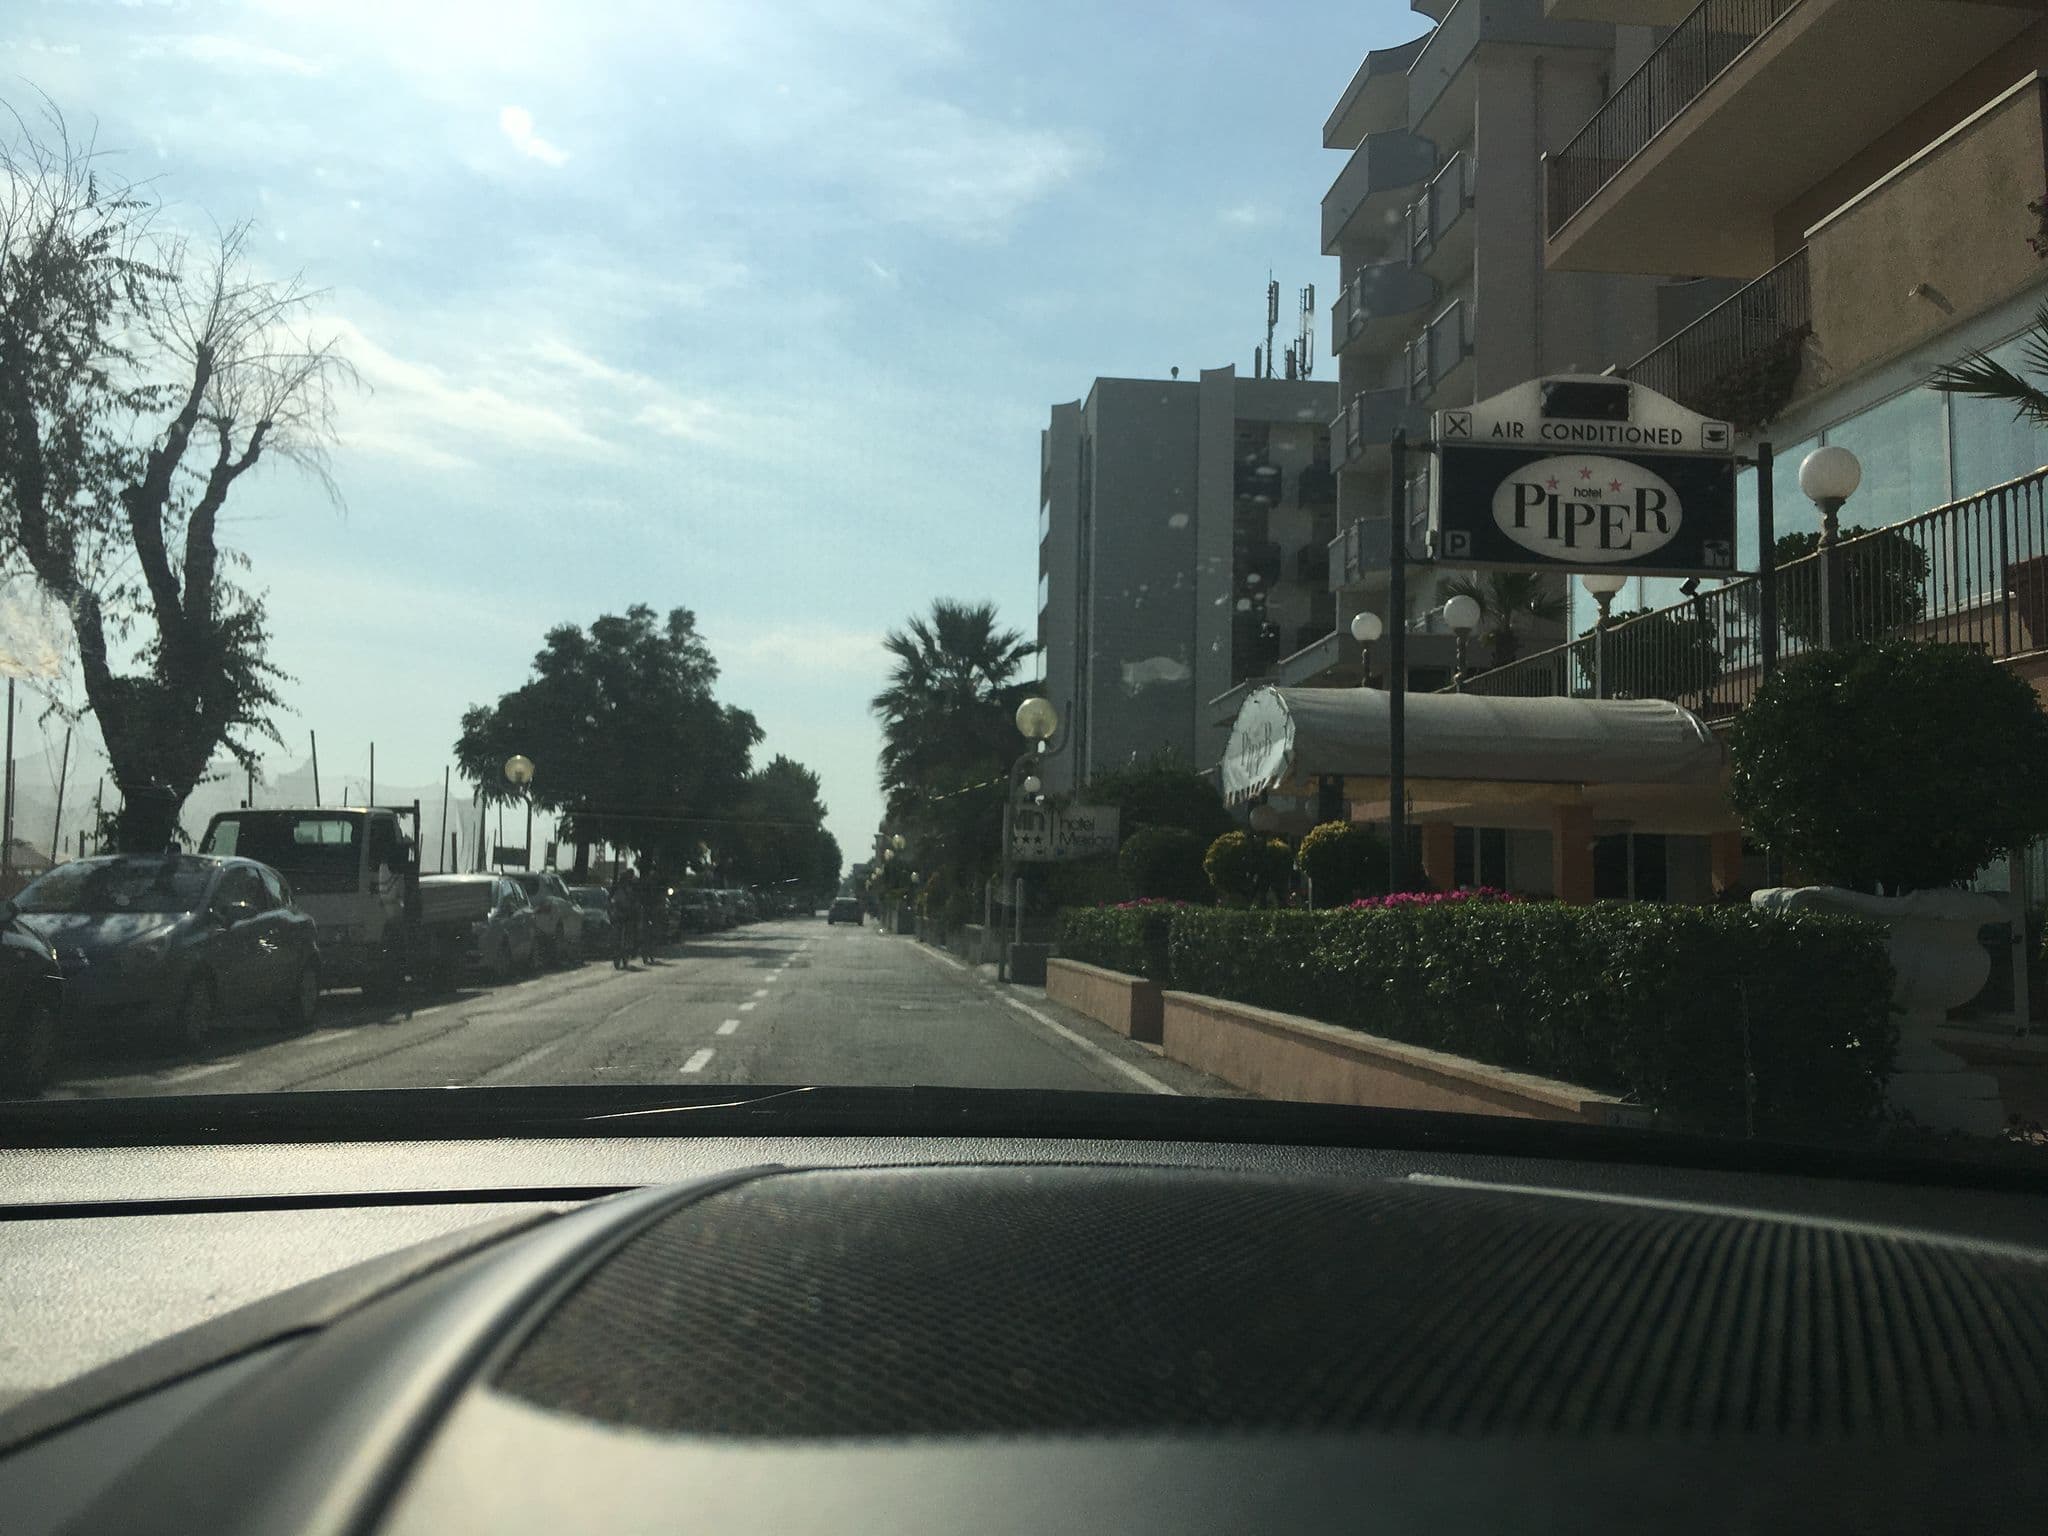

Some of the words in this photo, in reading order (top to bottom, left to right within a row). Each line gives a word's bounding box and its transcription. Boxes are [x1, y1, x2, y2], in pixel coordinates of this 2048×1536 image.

[1491, 421, 1525, 439] AIR
[1540, 422, 1684, 446] CONDITIONED
[1573, 485, 1602, 499] hotel
[1511, 482, 1672, 551] PIPER
